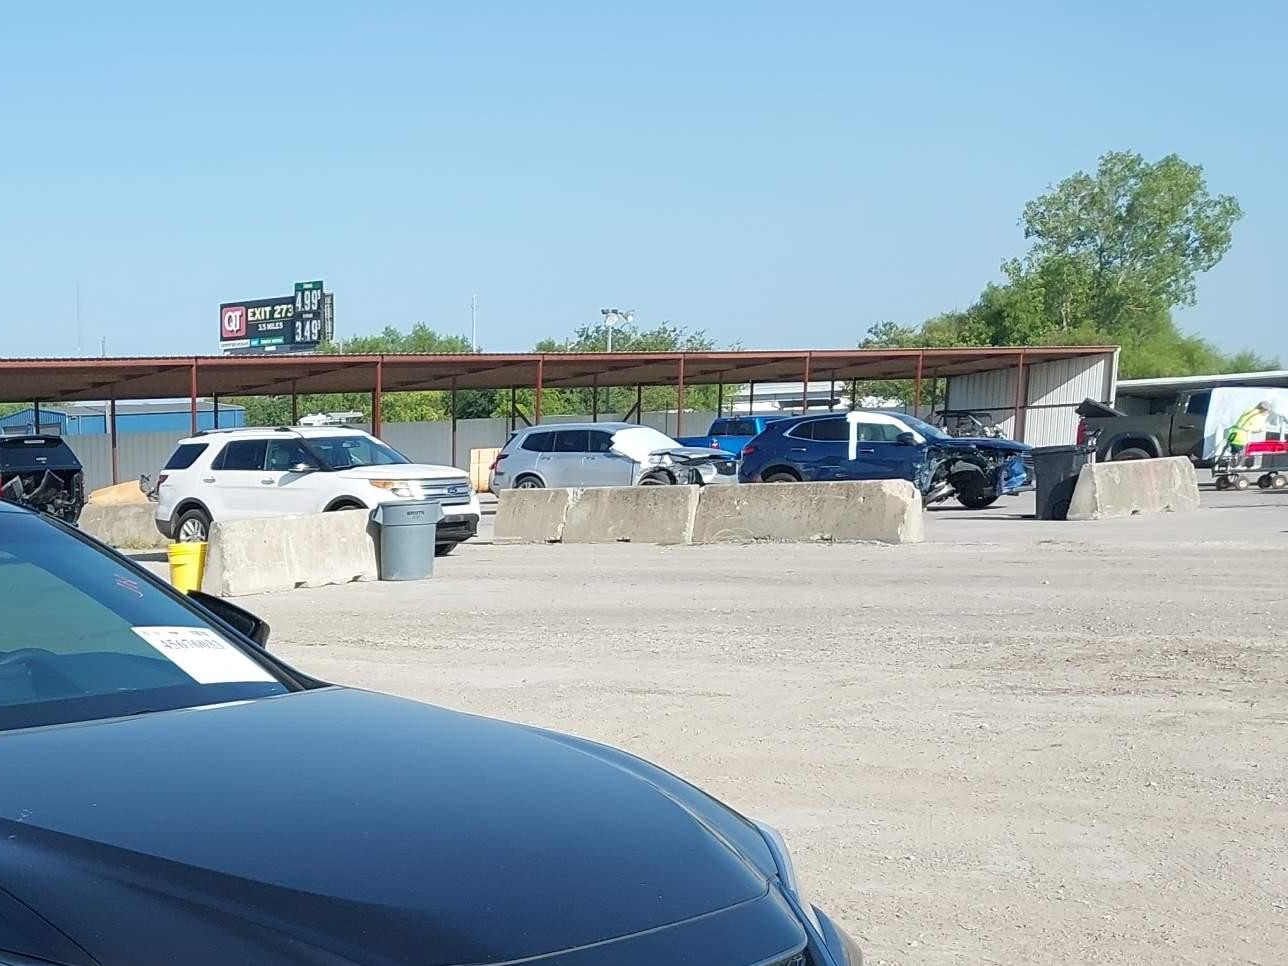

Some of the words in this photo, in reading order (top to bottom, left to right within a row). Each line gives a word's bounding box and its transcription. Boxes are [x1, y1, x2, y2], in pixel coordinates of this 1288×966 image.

[224, 310, 242, 332] QT
[248, 306, 271, 321] EXIT
[273, 304, 294, 318] 273
